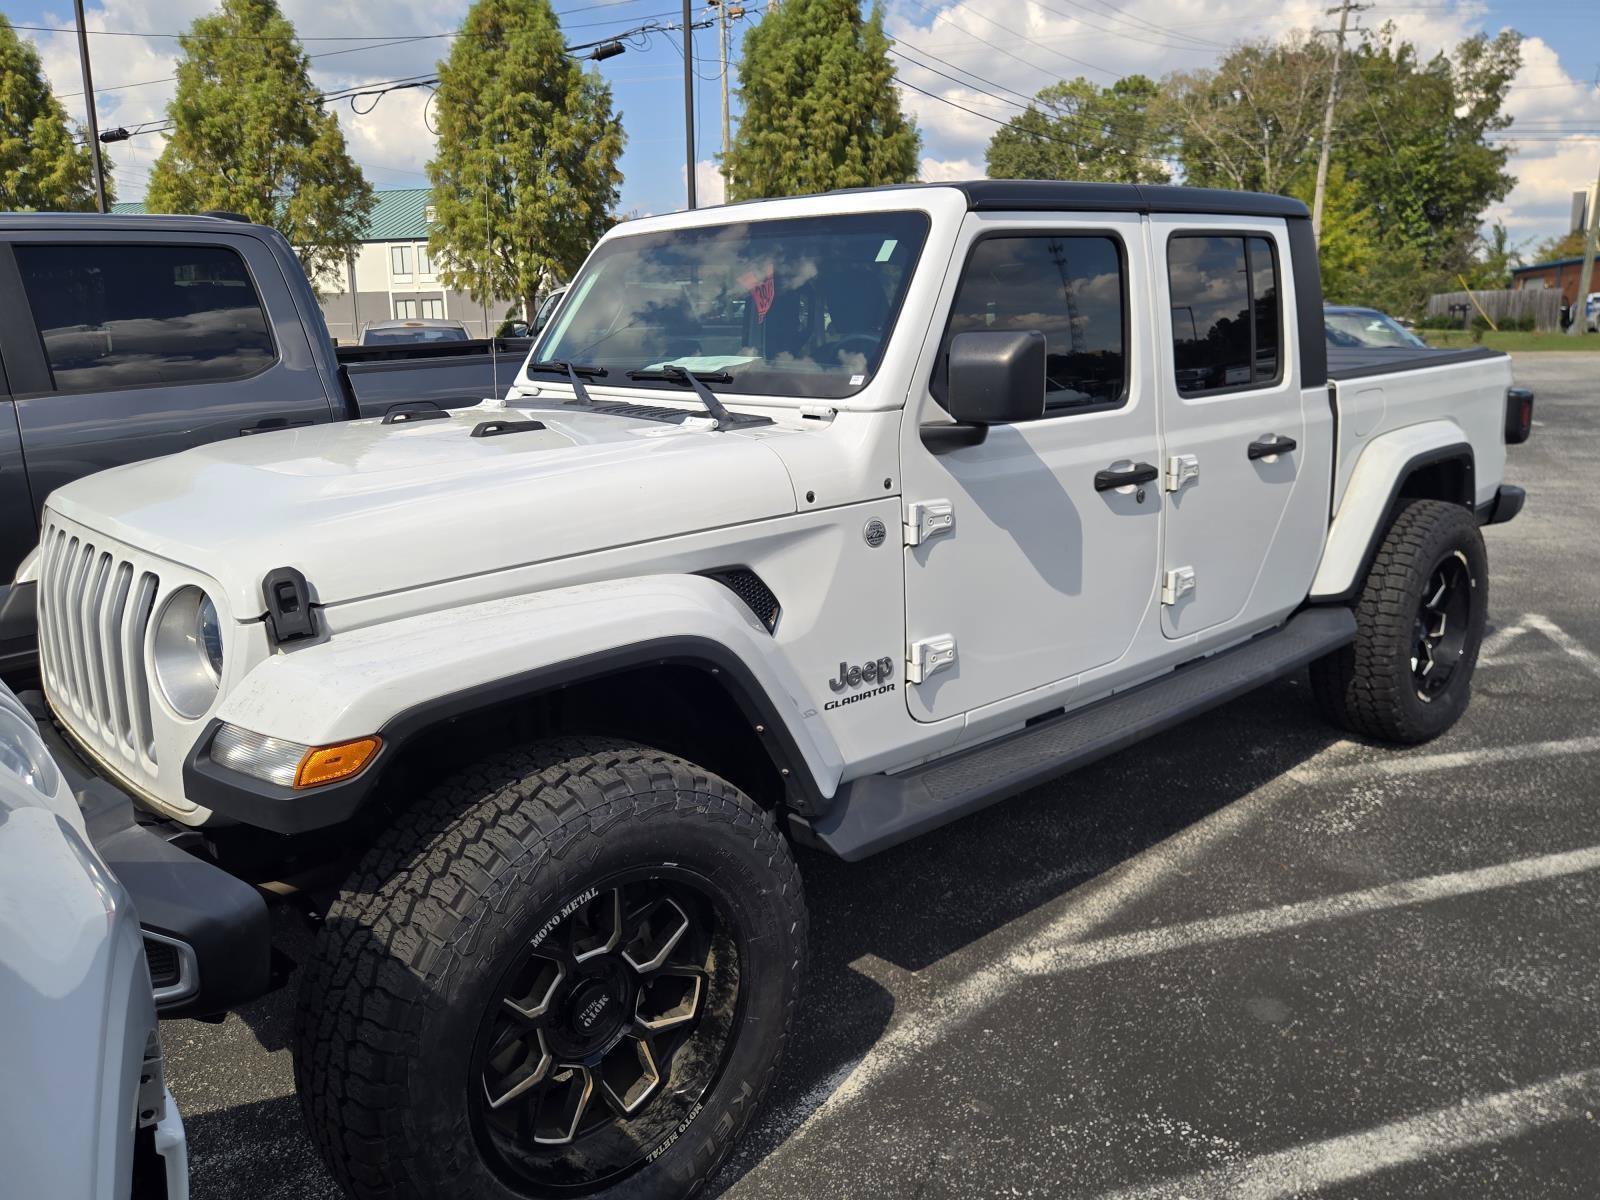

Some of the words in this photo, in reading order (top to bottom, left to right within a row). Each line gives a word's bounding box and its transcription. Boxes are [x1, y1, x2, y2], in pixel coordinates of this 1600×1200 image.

[829, 656, 893, 692] Jeep
[824, 683, 895, 711] GLADIATOR
[530, 915, 560, 948] MOTO
[560, 887, 599, 918] METAL
[678, 1102, 703, 1133] MOTO
[645, 1131, 679, 1163] METAL
